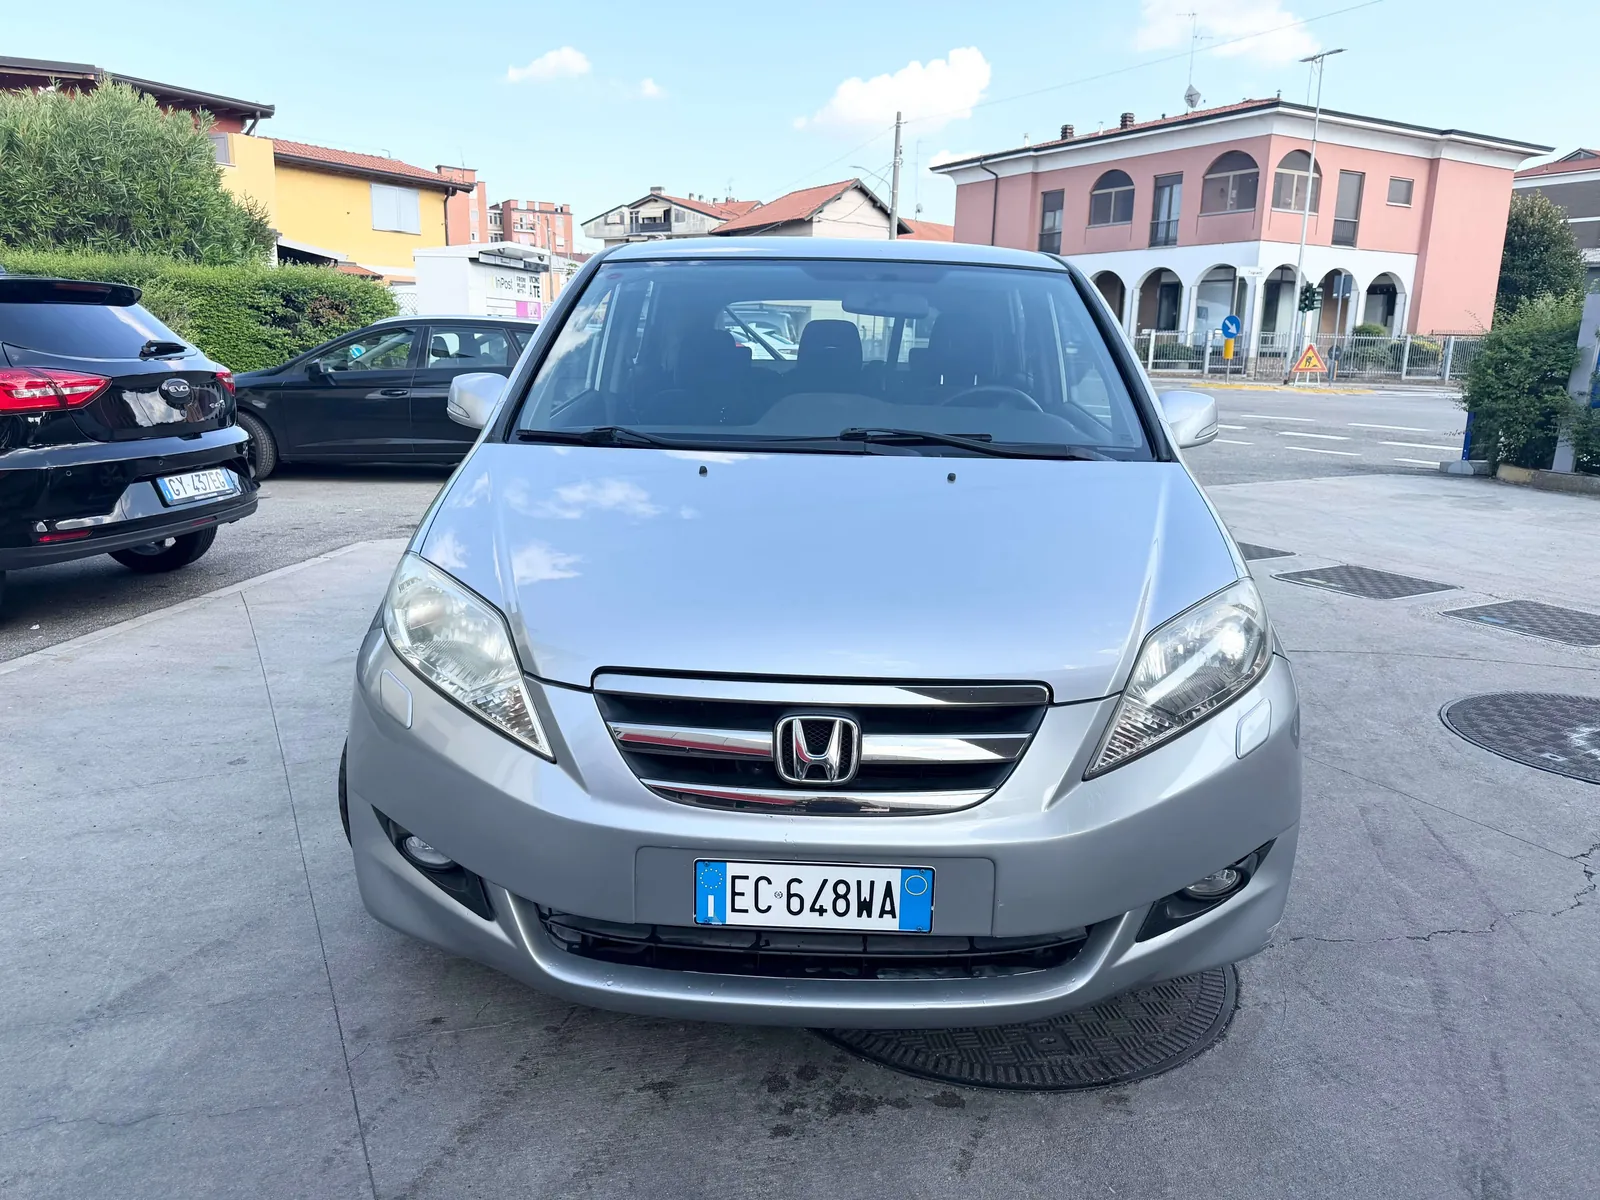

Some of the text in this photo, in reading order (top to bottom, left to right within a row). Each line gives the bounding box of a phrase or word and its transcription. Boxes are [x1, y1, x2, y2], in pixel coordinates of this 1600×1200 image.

[495, 276, 513, 290] InPost
[191, 471, 226, 492] 437EG
[730, 875, 772, 914] EC
[786, 878, 897, 919] 648WA
